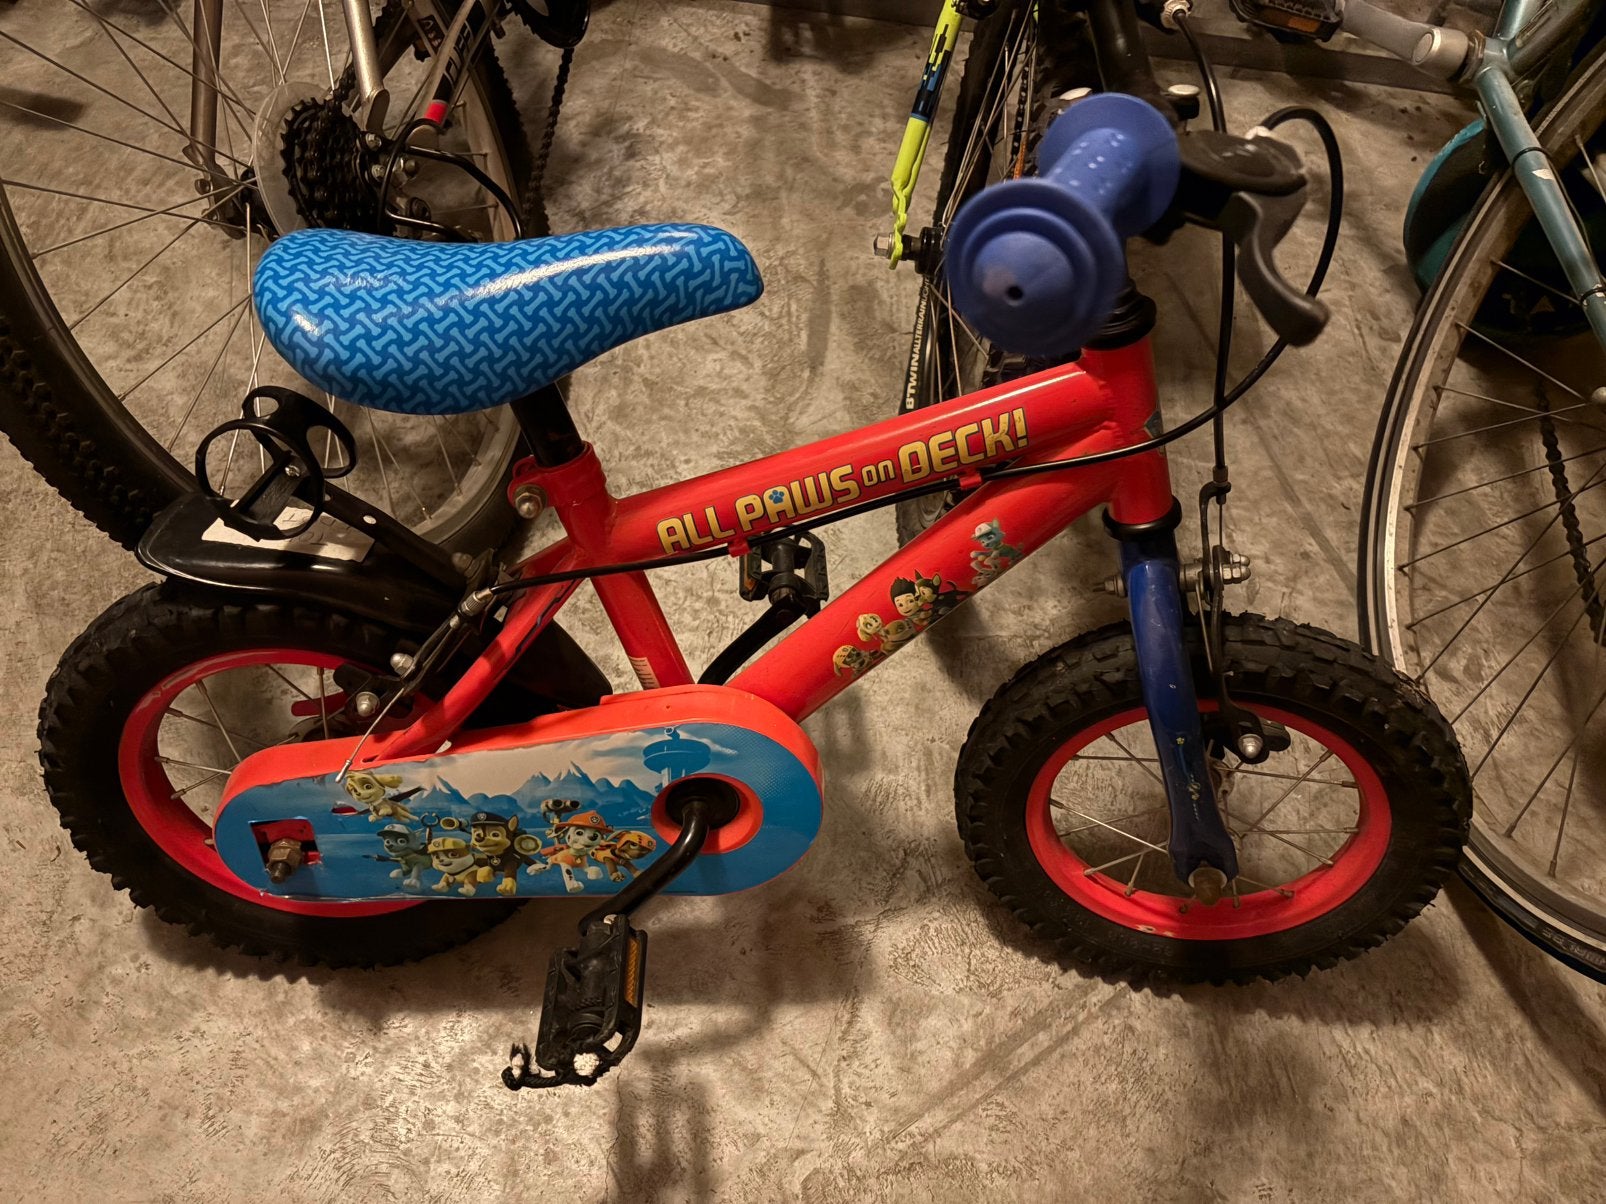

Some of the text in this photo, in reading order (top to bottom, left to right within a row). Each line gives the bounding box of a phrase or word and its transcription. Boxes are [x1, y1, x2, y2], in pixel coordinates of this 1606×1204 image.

[656, 407, 1028, 554] ALL PAWS on DECK!
